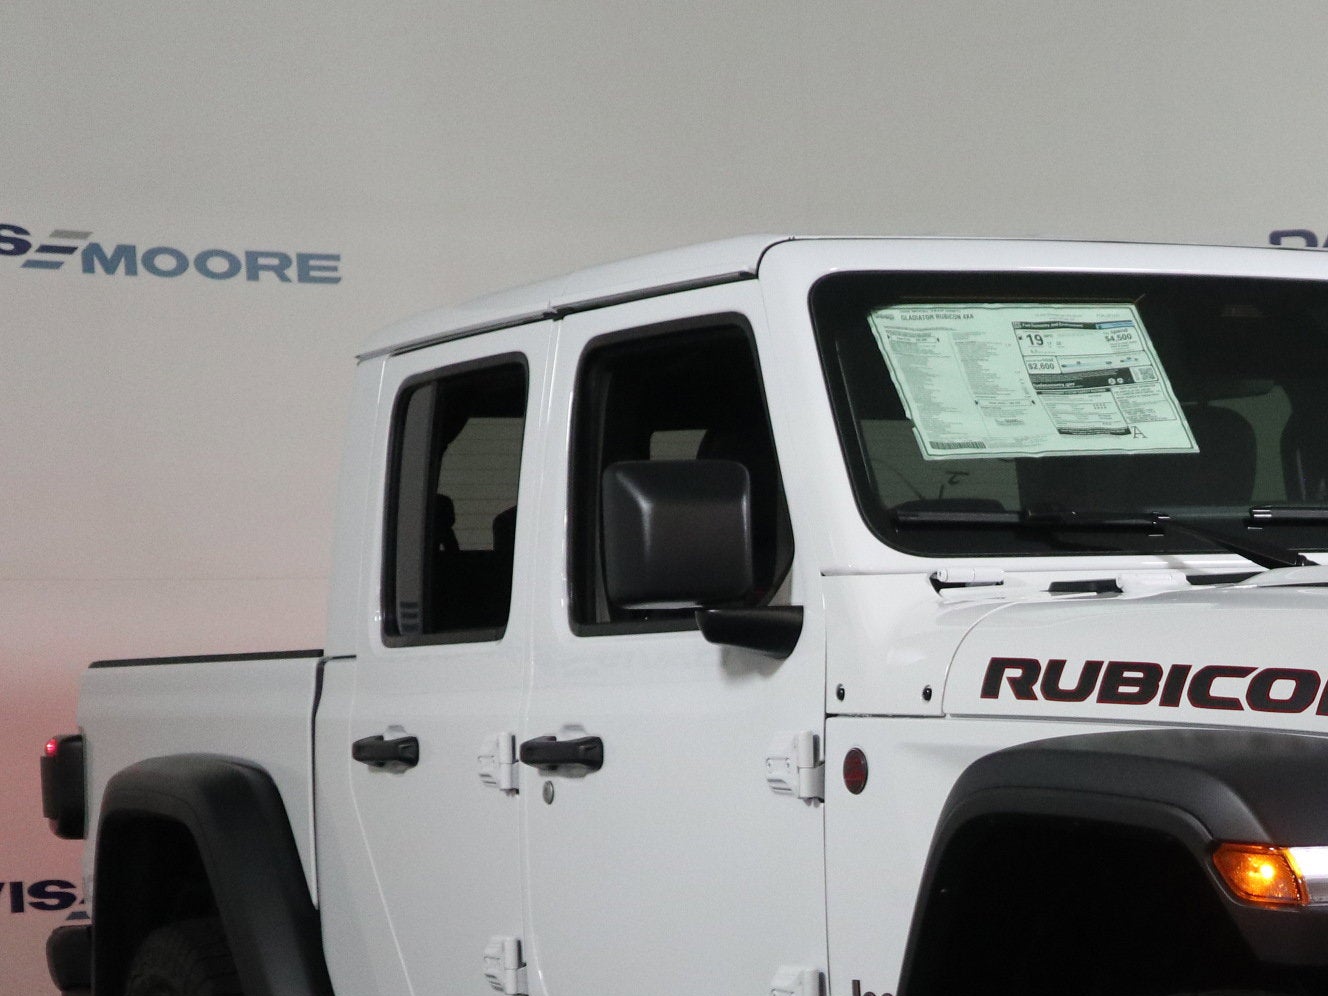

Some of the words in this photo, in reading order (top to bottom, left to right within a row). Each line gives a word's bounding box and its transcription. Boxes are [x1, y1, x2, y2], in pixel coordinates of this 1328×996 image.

[81, 242, 341, 285] MOORE
[1026, 334, 1044, 346] 19
[1131, 425, 1148, 439] A
